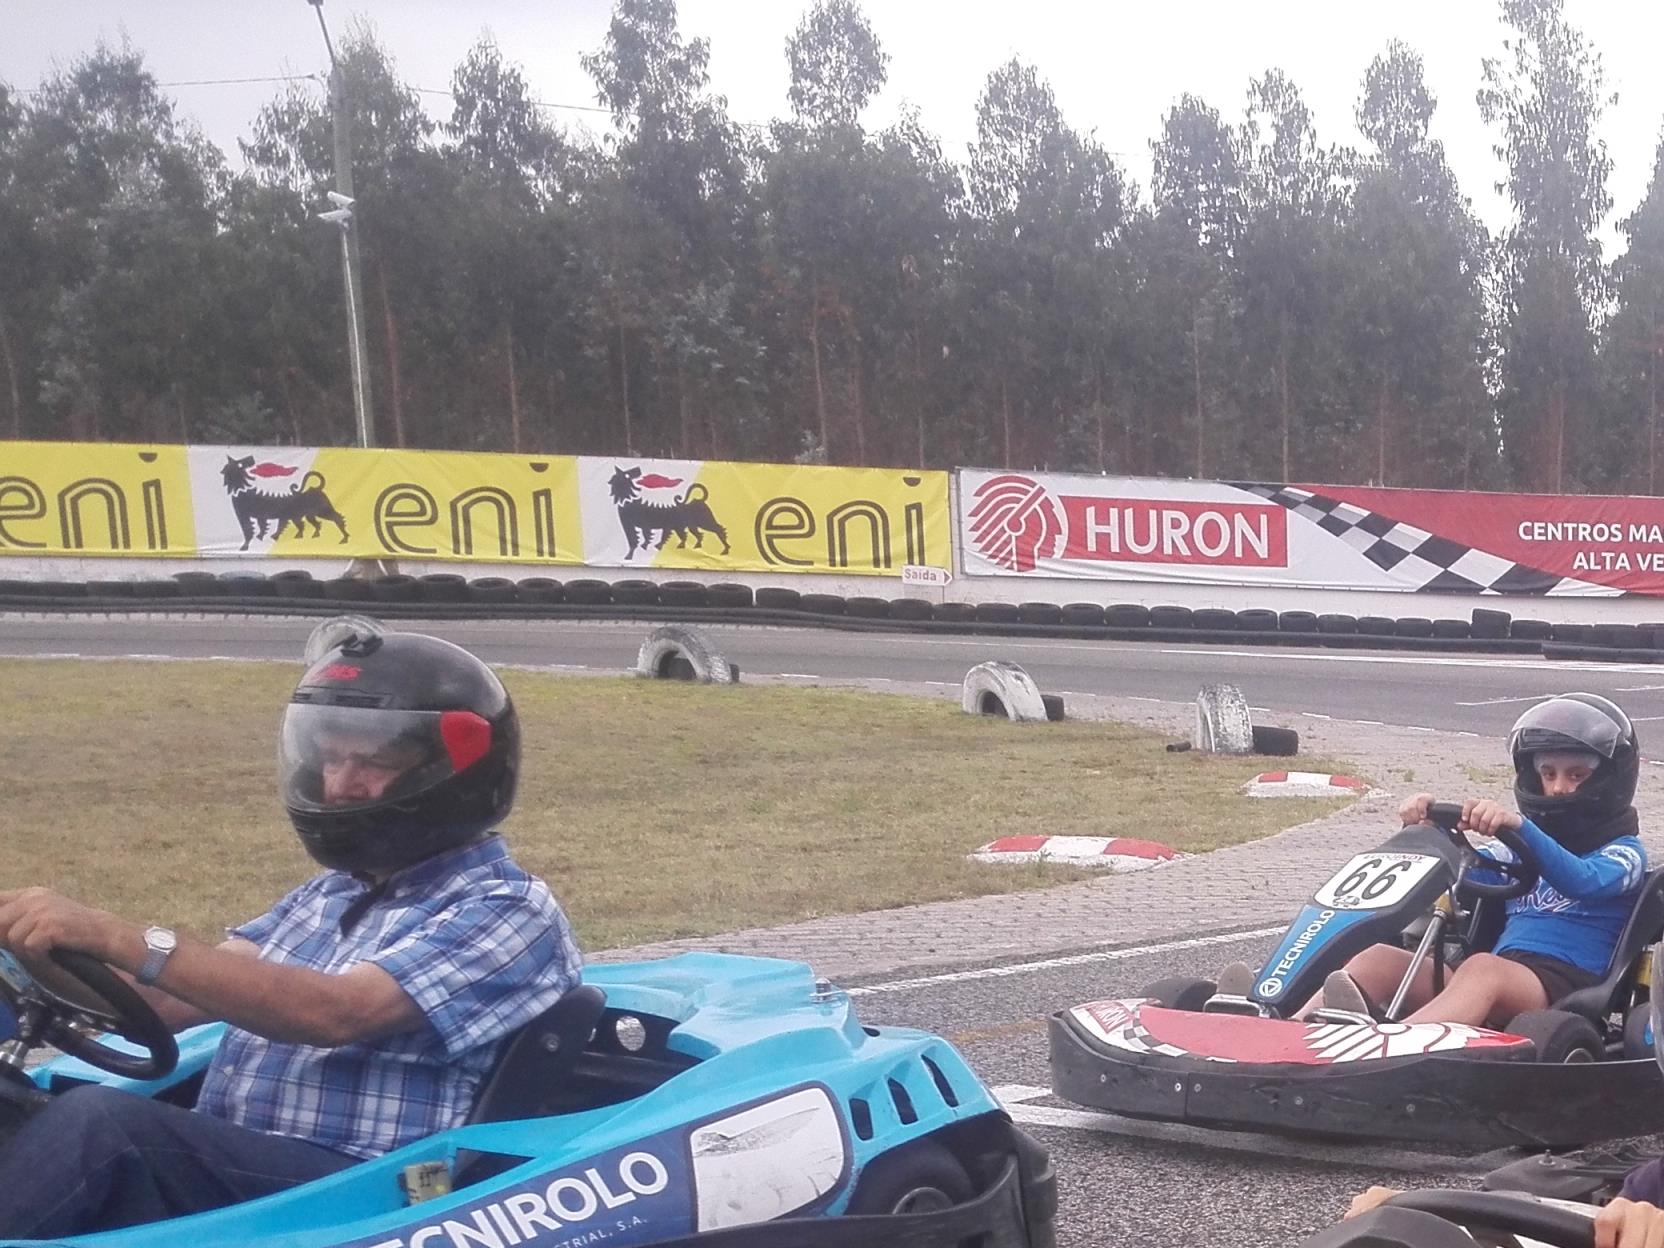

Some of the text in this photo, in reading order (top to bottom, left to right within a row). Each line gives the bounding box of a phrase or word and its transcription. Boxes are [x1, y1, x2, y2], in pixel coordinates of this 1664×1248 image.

[0, 452, 168, 549] eni
[374, 462, 556, 558] eni
[755, 477, 926, 569] eni
[1086, 505, 1269, 559] HURON
[1518, 521, 1623, 542] CENTROS
[1572, 551, 1631, 571] ALTA
[1333, 858, 1412, 900] 66
[1271, 909, 1336, 978] TECNIROLO
